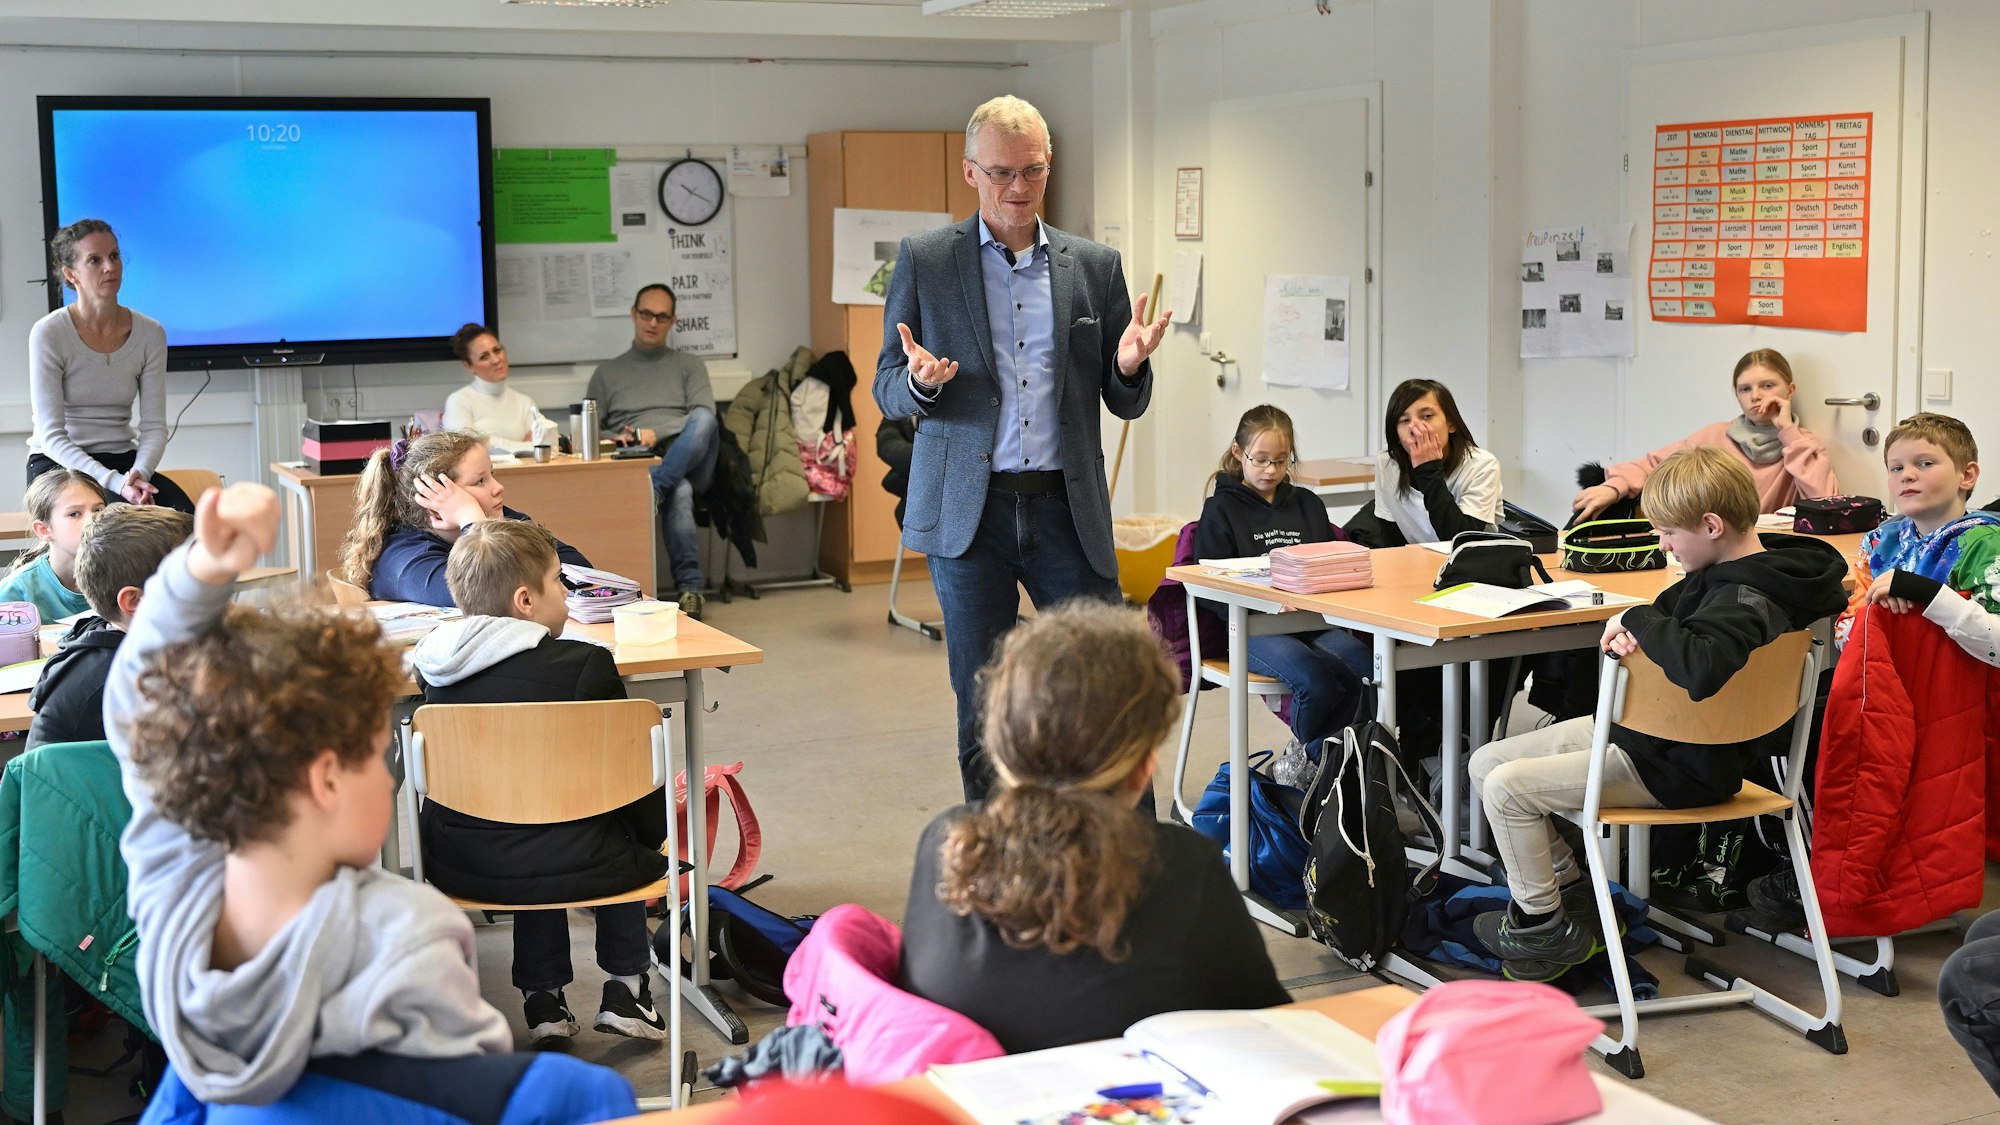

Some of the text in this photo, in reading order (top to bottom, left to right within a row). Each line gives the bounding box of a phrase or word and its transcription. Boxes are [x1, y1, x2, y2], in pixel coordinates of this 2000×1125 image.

[247, 124, 300, 142] 10:20
[1758, 126, 1790, 134] MITTWOCH
[1795, 121, 1826, 129] DONNERS-
[1762, 146, 1785, 154] Religion
[1802, 144, 1818, 152] Sport
[1801, 164, 1817, 172] Sport
[1760, 205, 1783, 213] Englisch
[670, 234, 706, 249] THINK
[1728, 244, 1742, 252] Sport
[1832, 243, 1856, 251] Englisch
[672, 275, 698, 289] PAIR
[676, 317, 710, 333] SHARE
[1253, 533, 1264, 541] Die
[1264, 529, 1279, 538] Welt
[1265, 537, 1293, 546] Plenarsaal
